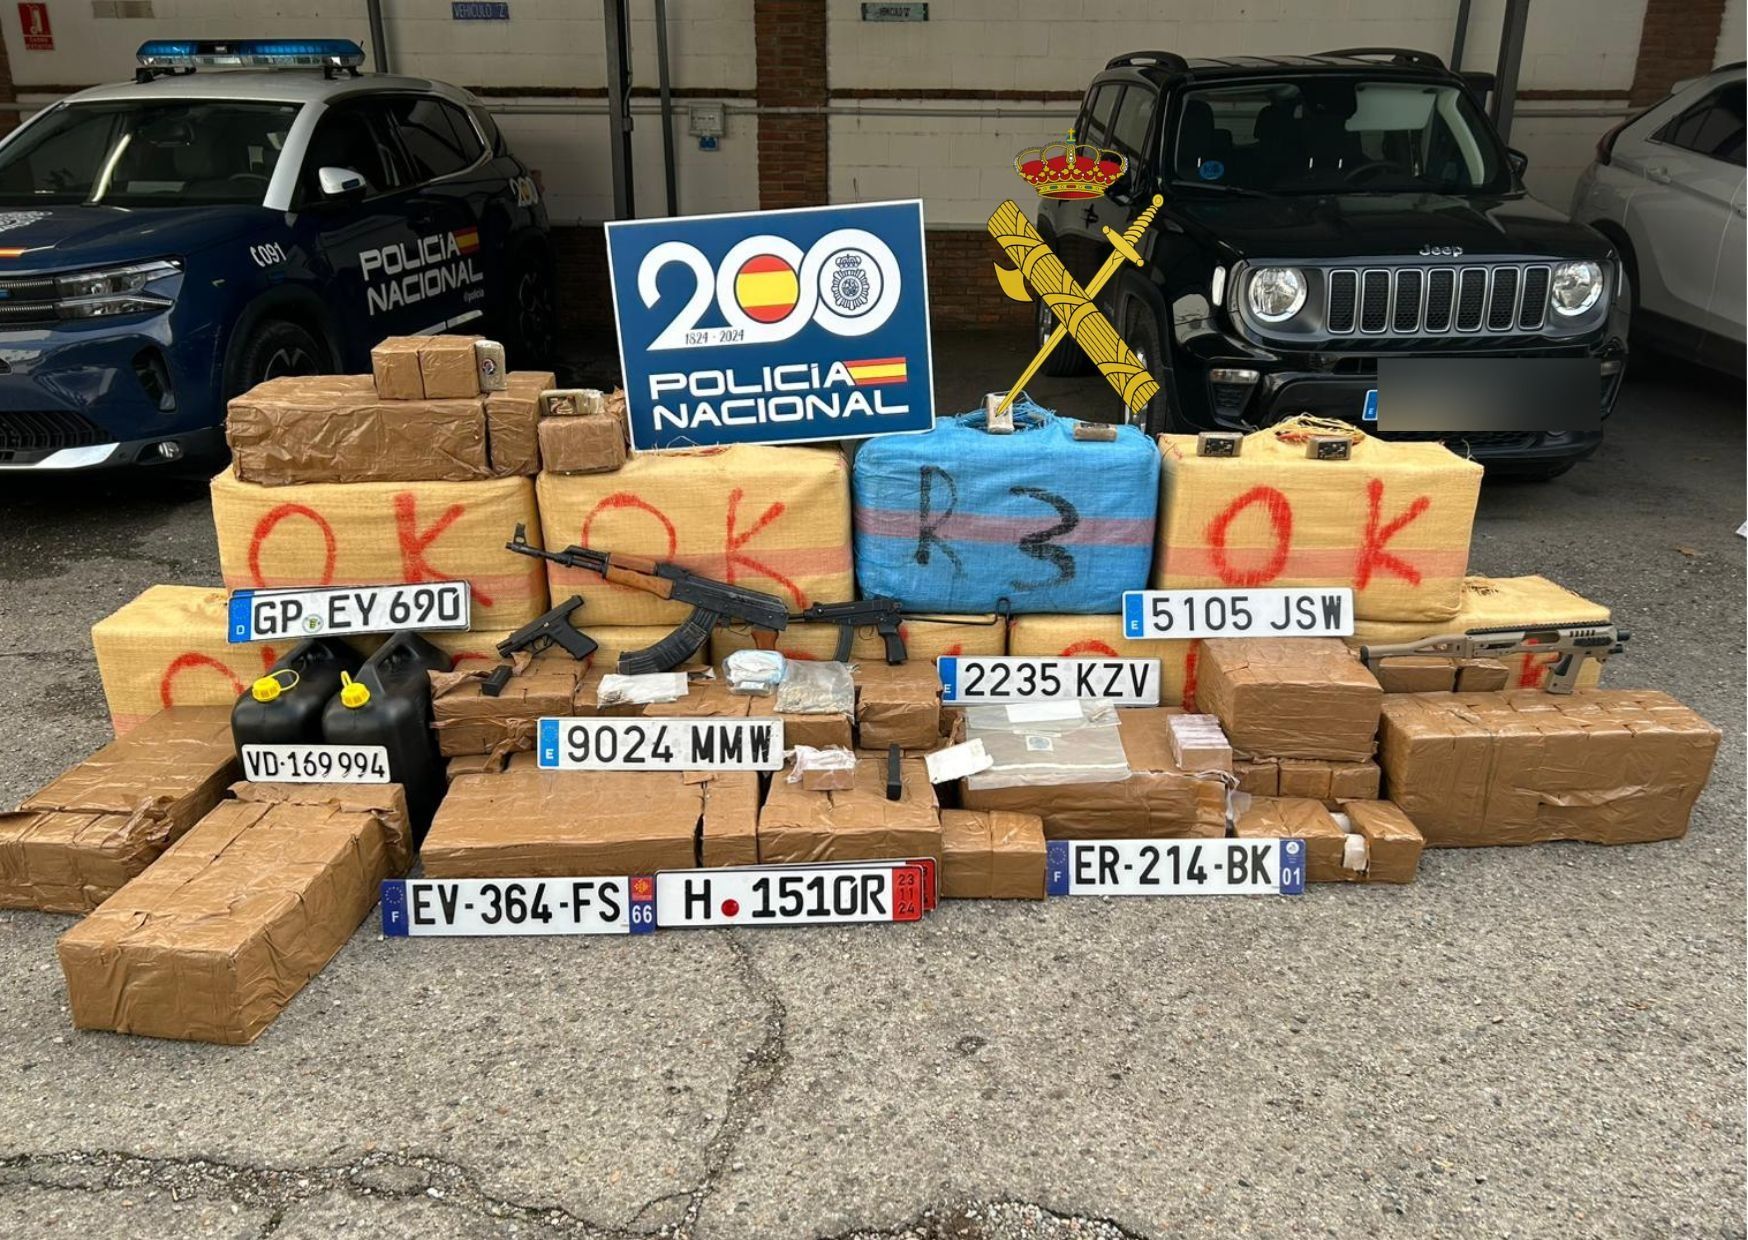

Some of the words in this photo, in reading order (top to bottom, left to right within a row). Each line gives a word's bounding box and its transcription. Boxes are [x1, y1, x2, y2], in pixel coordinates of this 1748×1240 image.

[1419, 244, 1463, 258] Jeep
[367, 258, 483, 316] NACIONAL
[638, 228, 901, 351] 200
[685, 332, 708, 345] 1824
[719, 329, 744, 343] 2024
[653, 390, 909, 430] NACIONAL
[235, 624, 245, 636] D
[254, 599, 303, 635] GP
[328, 592, 377, 629] EY
[389, 586, 459, 624] 690
[1131, 620, 1139, 631] E
[1152, 596, 1252, 631] 5105
[1270, 595, 1341, 630] JSW
[944, 684, 952, 694] E
[965, 663, 1061, 696] 2235
[1077, 663, 1150, 697] KZV
[545, 748, 554, 760] E
[567, 725, 673, 763] 9024
[691, 725, 771, 763] MMW
[899, 873, 914, 886] 23
[1053, 871, 1062, 883] F
[1075, 845, 1272, 885] ER-214-BK
[1282, 867, 1301, 886] 01
[391, 911, 400, 923] F
[412, 882, 620, 925] EV-364-FS
[631, 904, 652, 924] 66
[685, 879, 711, 919] H
[752, 874, 886, 918] 1510R
[898, 901, 915, 914] 24
[900, 887, 914, 900] 11
